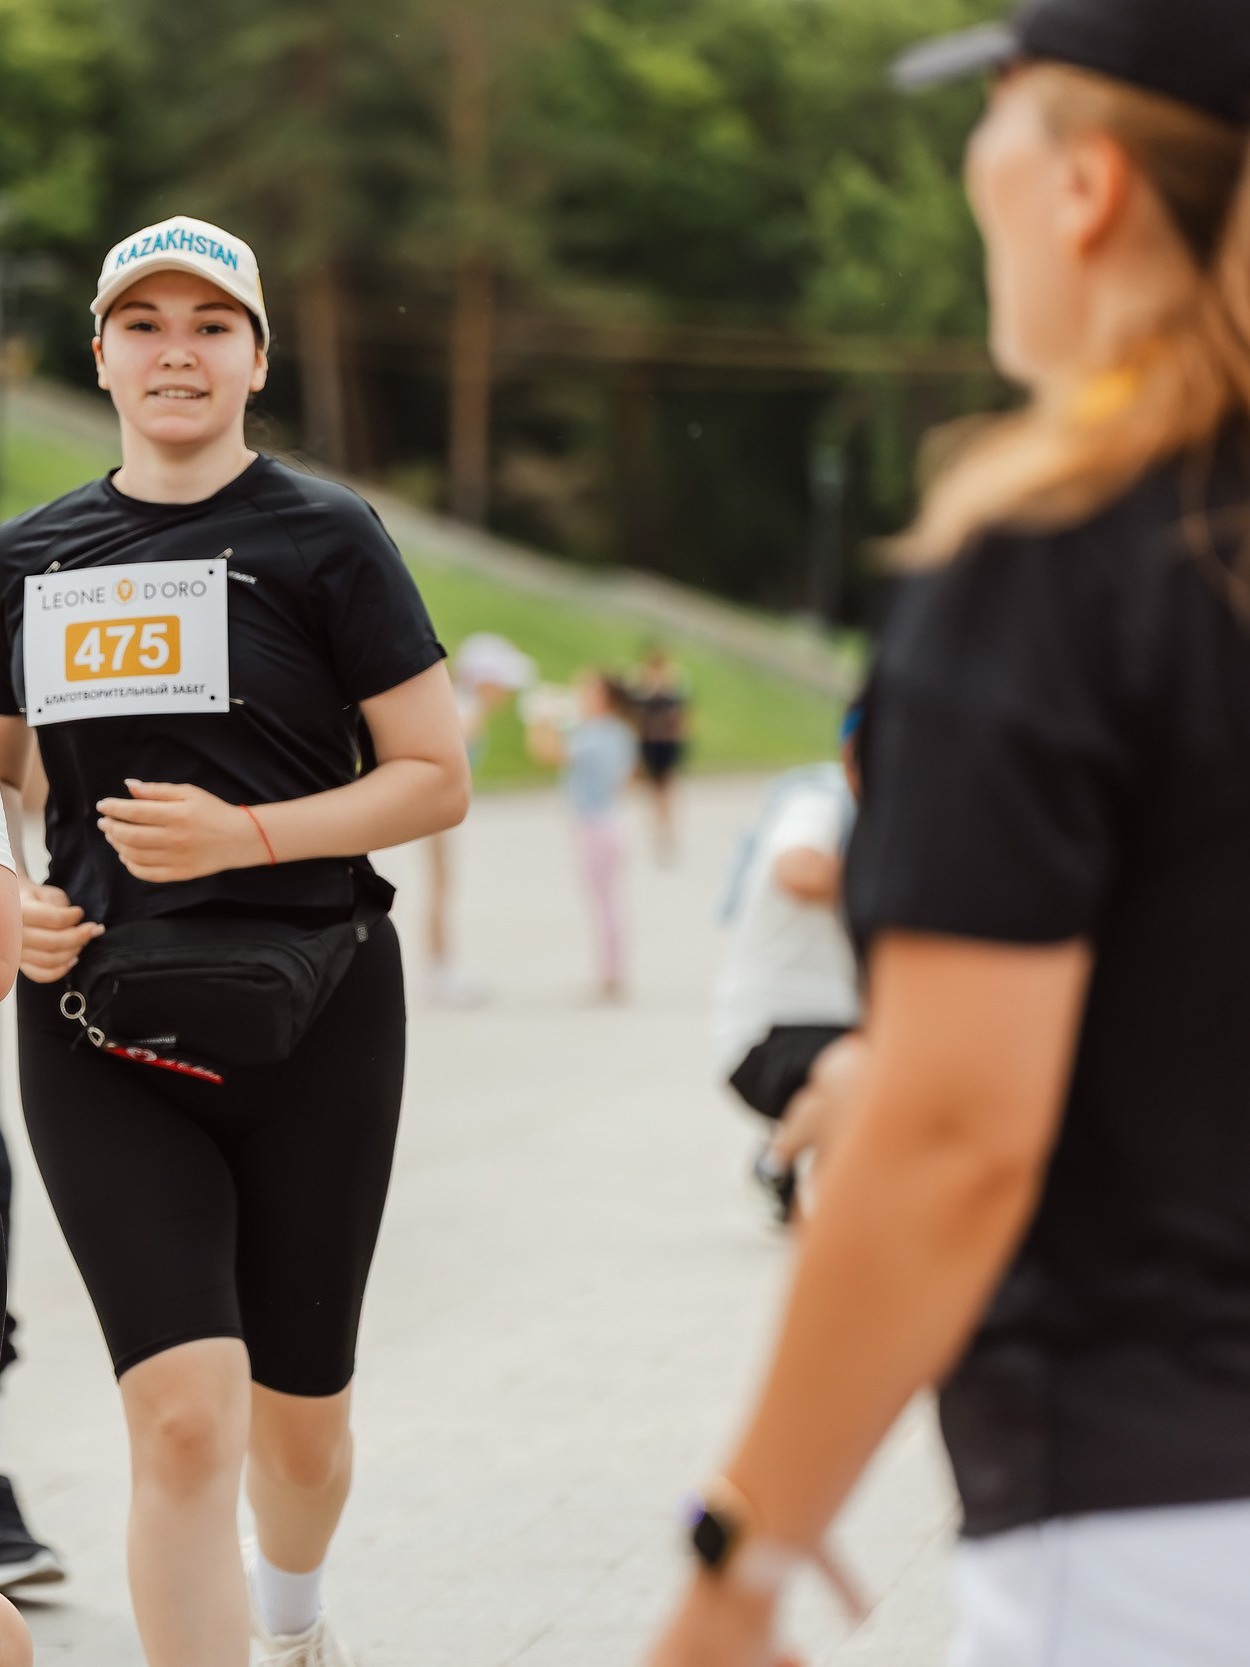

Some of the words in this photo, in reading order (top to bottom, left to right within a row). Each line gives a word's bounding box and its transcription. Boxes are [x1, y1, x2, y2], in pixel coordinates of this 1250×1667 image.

[116, 228, 238, 270] KAZAKHSTAN
[42, 587, 105, 610] LEONE
[144, 580, 206, 600] D'ORO
[73, 622, 169, 673] 475
[45, 683, 168, 705] БЛАГОТВОРИТЕЛЬНЫЙ
[172, 684, 205, 695] ЗАБЕГ
